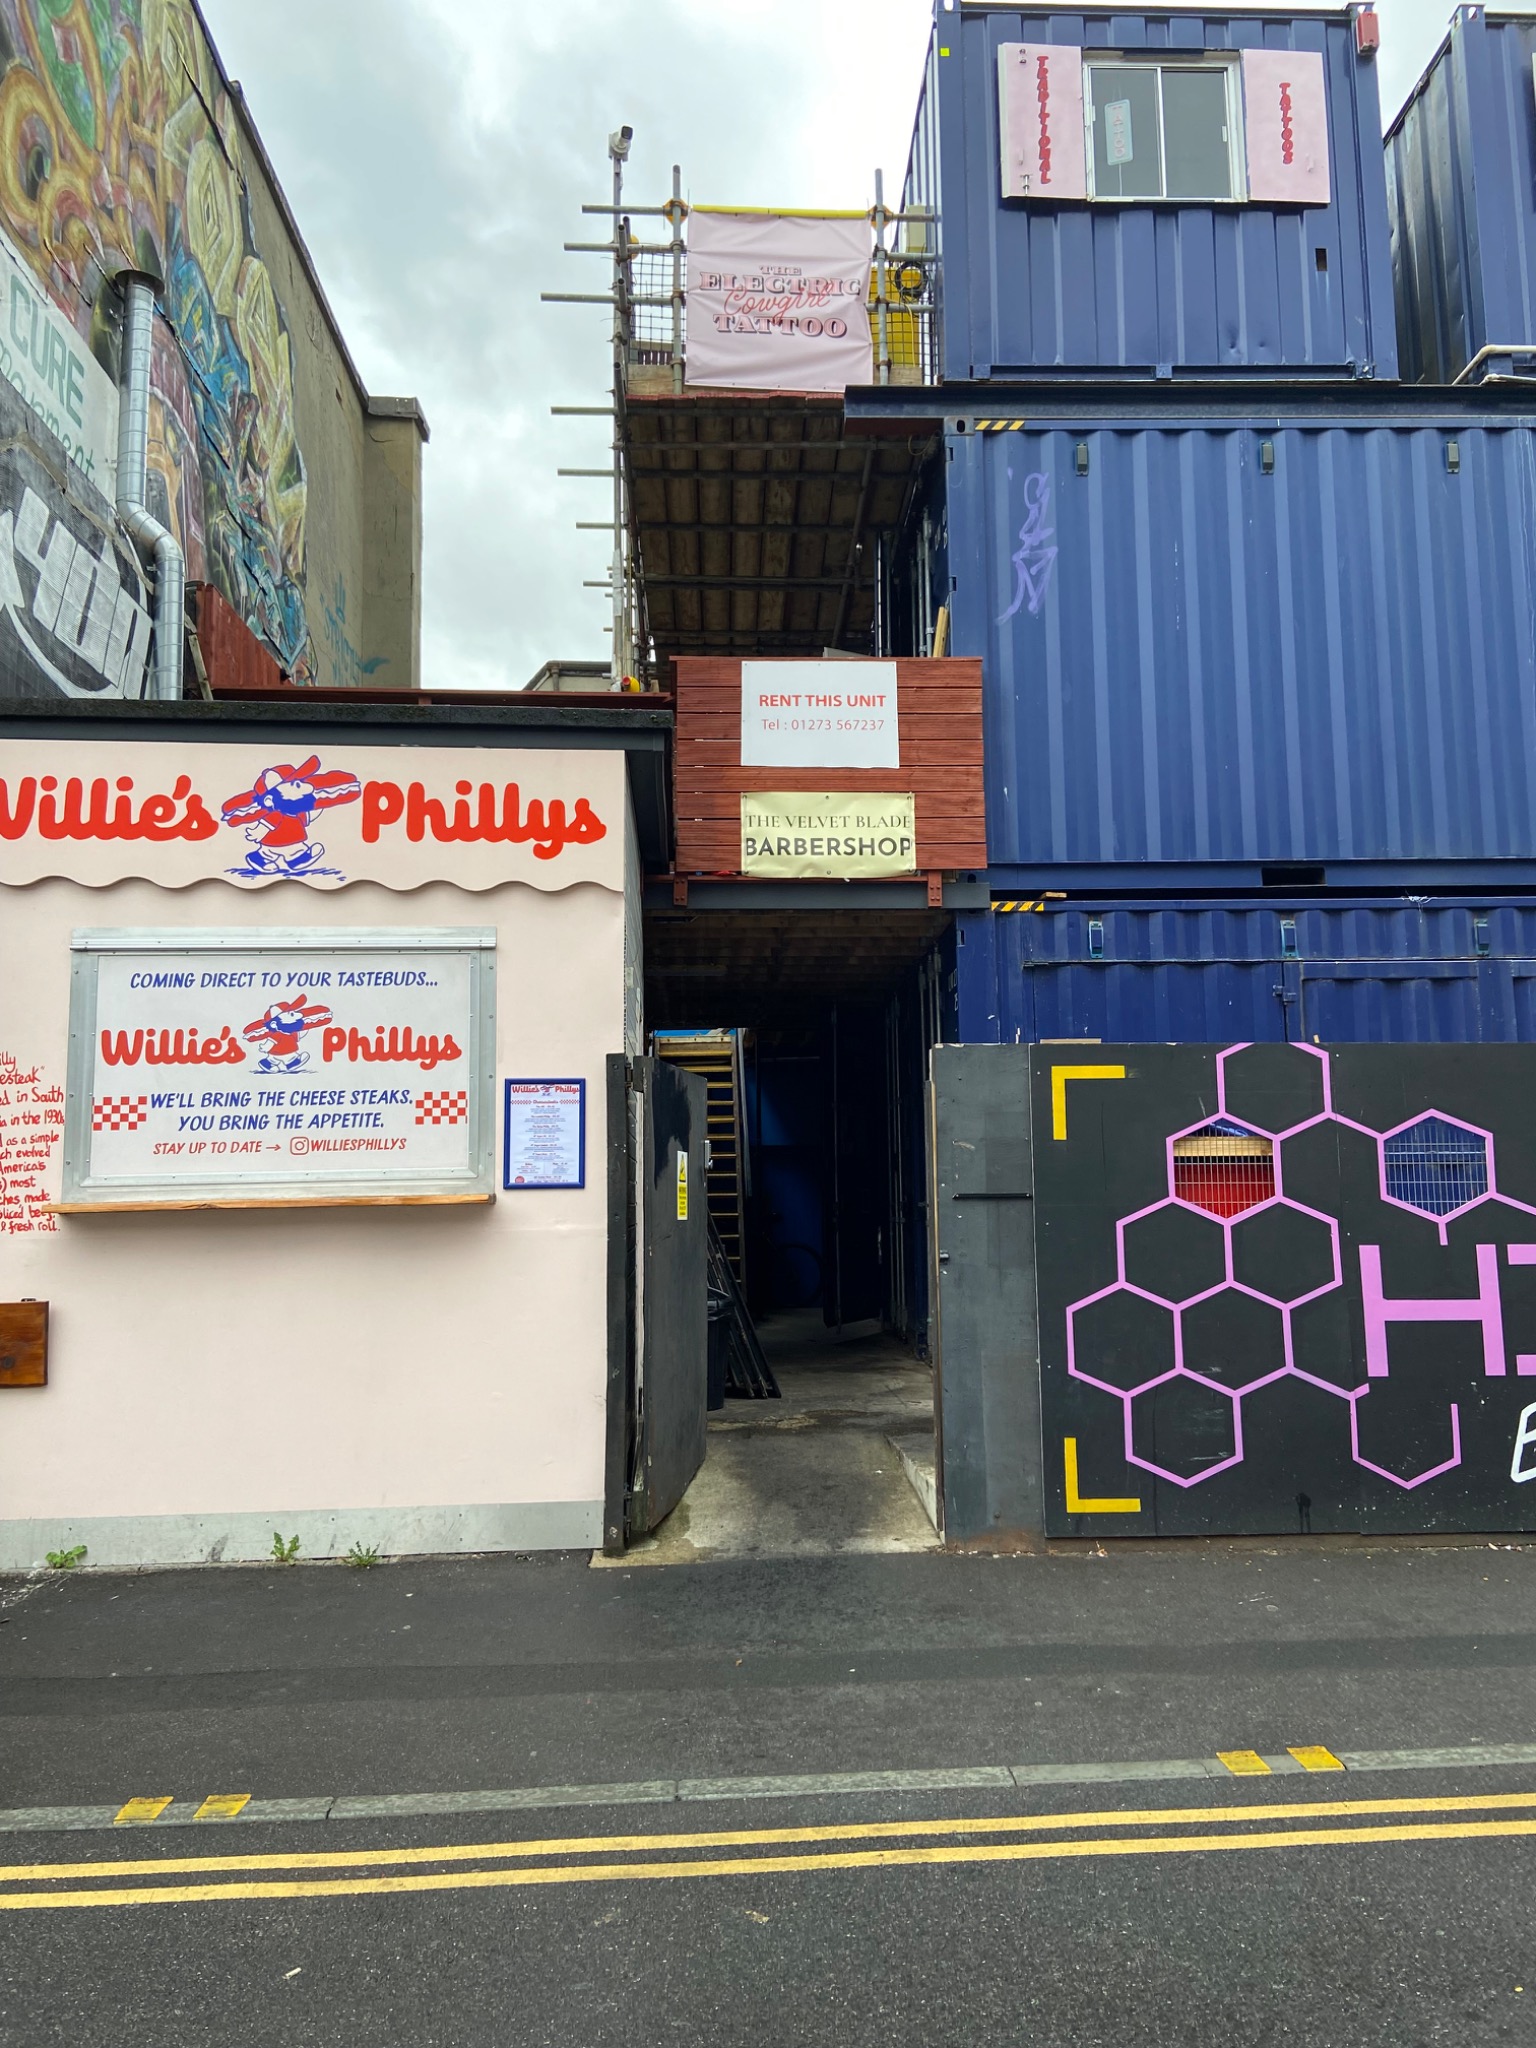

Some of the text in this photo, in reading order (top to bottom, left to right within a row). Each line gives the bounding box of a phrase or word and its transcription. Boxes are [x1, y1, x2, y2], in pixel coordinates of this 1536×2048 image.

[1036, 56, 1051, 185] TRADITIONAL
[1279, 82, 1293, 165] TATTOOS
[759, 265, 802, 276] THE
[700, 271, 861, 296] ELECTRIC
[723, 281, 835, 326] Cowgirl
[713, 313, 847, 338] TATTOO
[9, 273, 85, 430] CURE
[759, 694, 887, 707] RENT THIS UNIT
[761, 718, 780, 731] Tel
[791, 719, 832, 731] 01273
[836, 719, 885, 731] 567237
[361, 780, 607, 861] Phillys
[745, 814, 911, 829] THE VELVET BLADE
[745, 836, 912, 857] BARBERSHOP
[130, 970, 439, 989] COMING DIRECT TO YOUR TASTEBUDS...
[100, 1026, 463, 1071] Willie's Phillys
[16, 1090, 28, 1102] in
[31, 1085, 64, 1103] South
[150, 1088, 413, 1109] WE'LL BRING THE CHEESE STEAKS.
[10, 1113, 20, 1126] in
[21, 1110, 40, 1125] the
[178, 1112, 385, 1132] YOU BRING THE APPETITE.
[6, 1137, 18, 1146] as
[20, 1137, 27, 1145] a
[29, 1129, 60, 1149] simple
[152, 1137, 407, 1155] STAY UP TO DATE WILLIESPHILLYS
[16, 1145, 51, 1158] evolved
[9, 1175, 37, 1188] most
[24, 1189, 51, 1203] made
[8, 1219, 35, 1234] fresh
